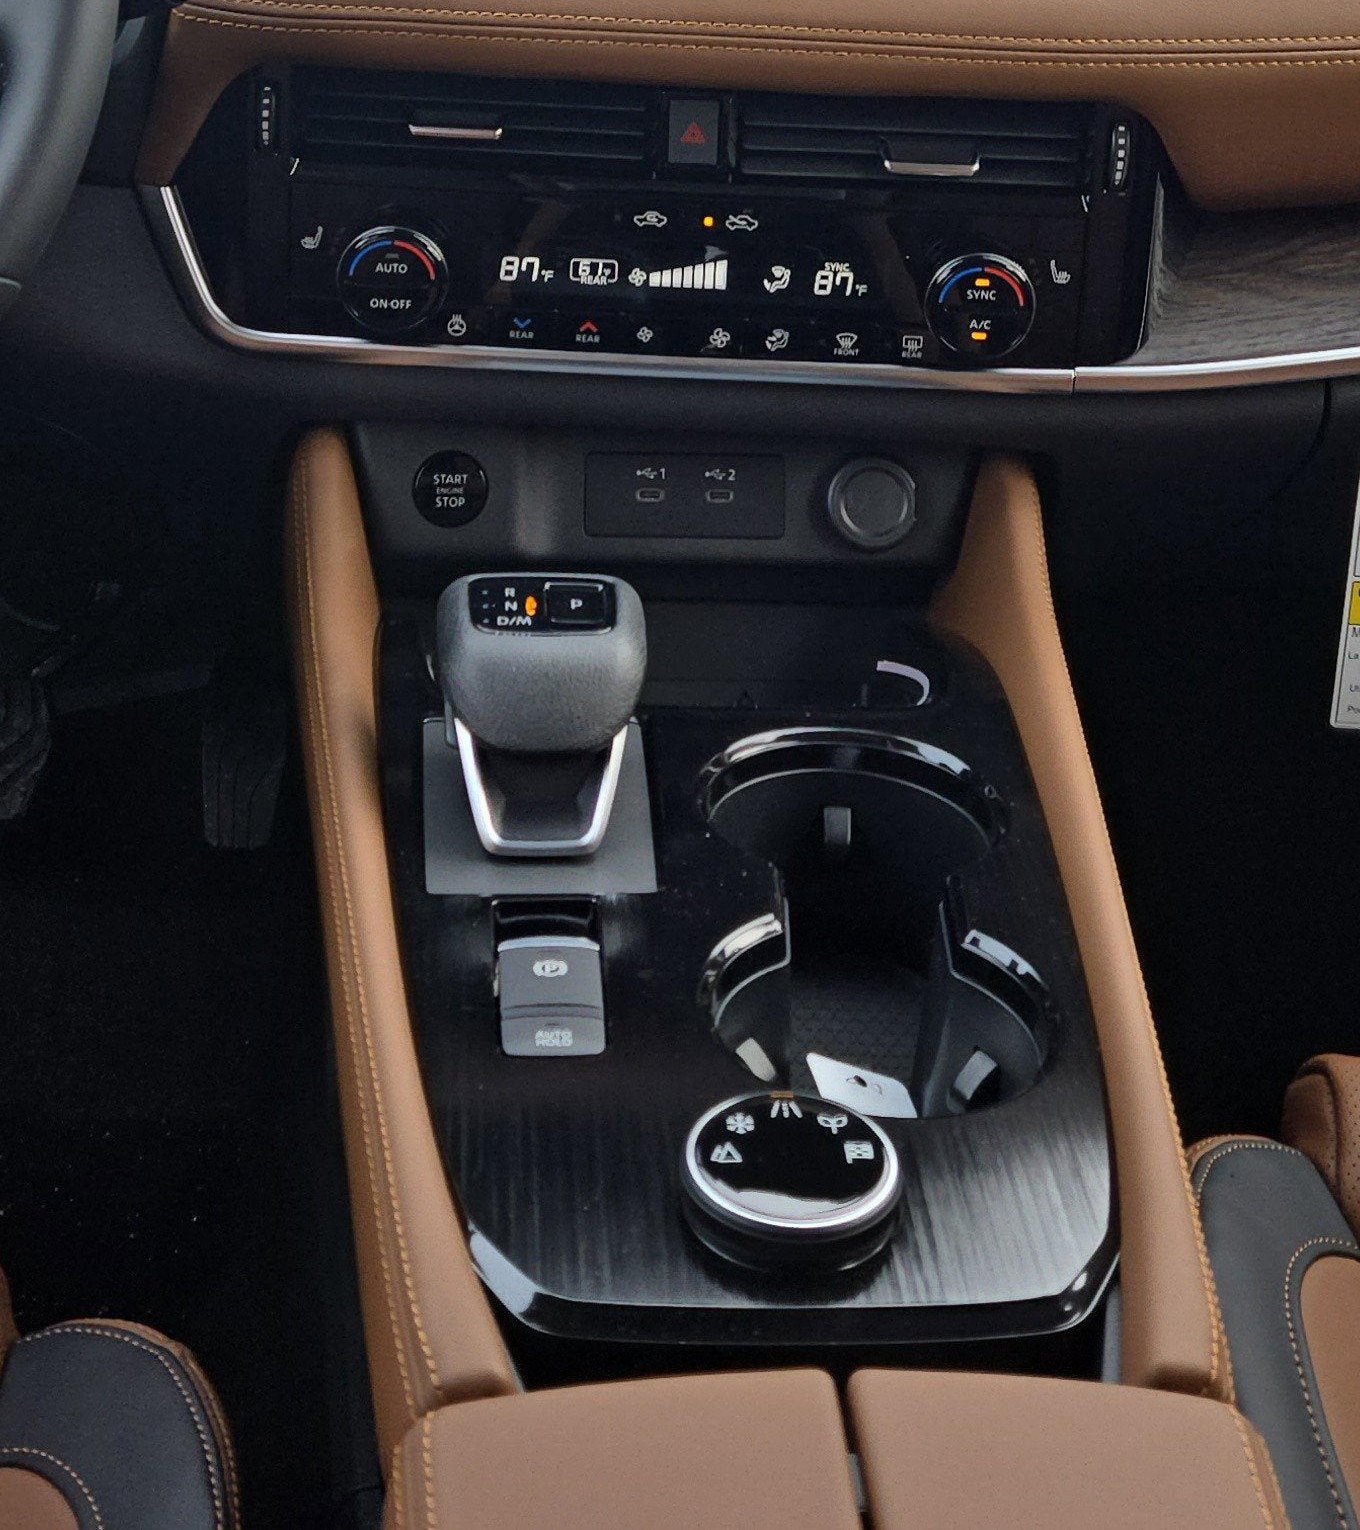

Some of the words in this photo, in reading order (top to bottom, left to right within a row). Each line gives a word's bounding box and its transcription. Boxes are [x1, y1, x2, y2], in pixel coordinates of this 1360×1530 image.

[375, 262, 408, 274] AUTO
[824, 261, 850, 272] SYNC
[967, 290, 996, 301] SYNC
[969, 319, 991, 330] A/C
[509, 330, 534, 340] REAR
[575, 334, 600, 344] REAR
[433, 473, 468, 485] START
[728, 470, 736, 481] 2
[436, 487, 464, 495] ENGINE
[435, 496, 466, 508] STOP
[505, 587, 515, 597] R
[505, 601, 518, 611] N
[570, 598, 583, 610] P
[497, 615, 532, 626] D/M
